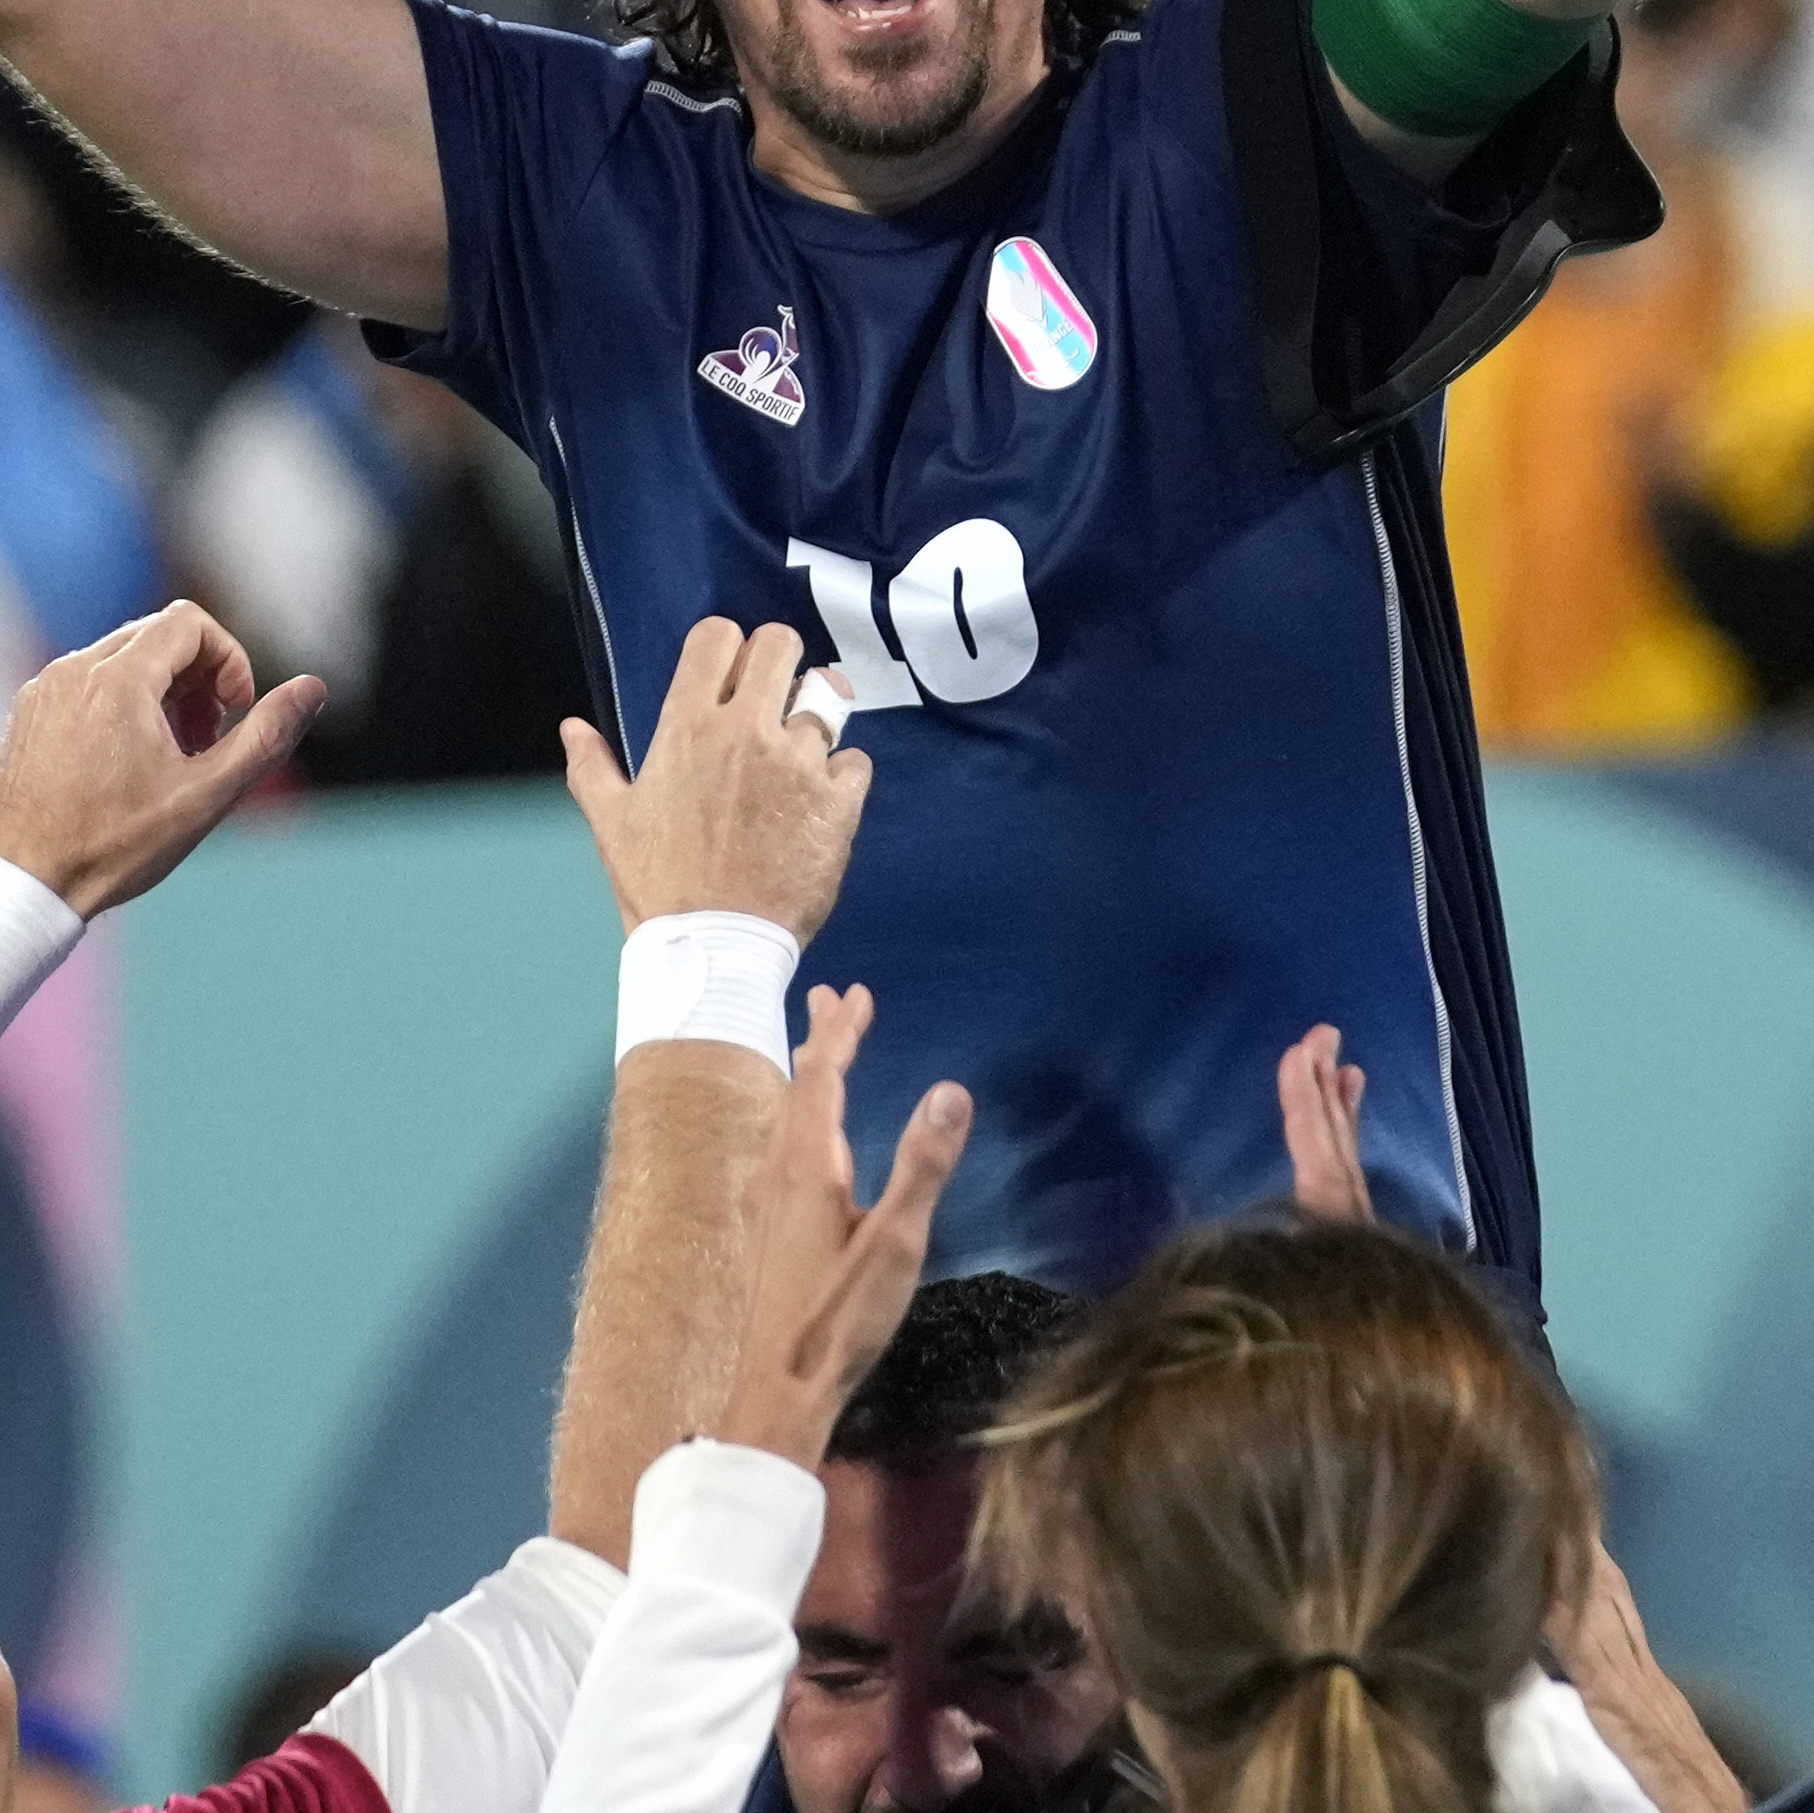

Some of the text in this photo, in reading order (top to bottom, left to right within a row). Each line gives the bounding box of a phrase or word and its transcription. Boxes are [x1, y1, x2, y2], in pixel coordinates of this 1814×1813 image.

[701, 359, 800, 421] LE COQ SPORTIF
[786, 518, 1039, 712] 10
